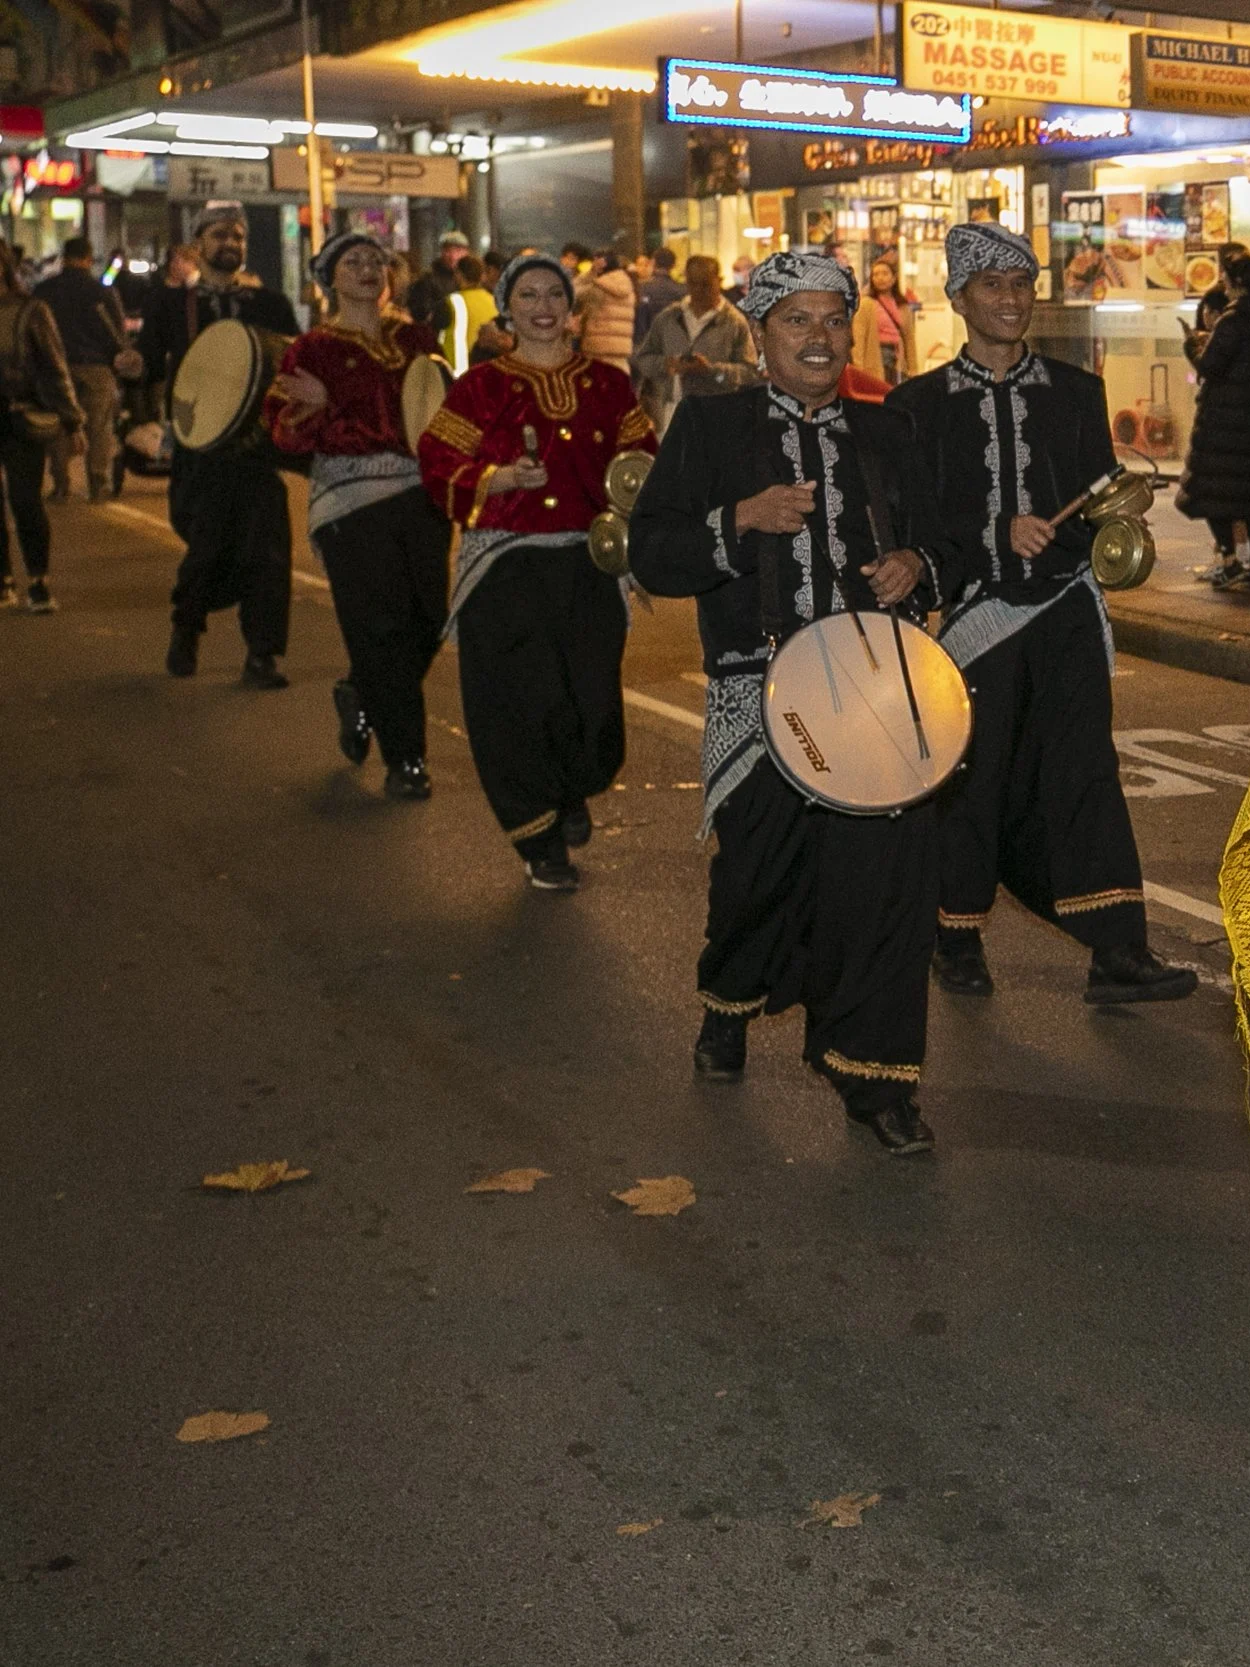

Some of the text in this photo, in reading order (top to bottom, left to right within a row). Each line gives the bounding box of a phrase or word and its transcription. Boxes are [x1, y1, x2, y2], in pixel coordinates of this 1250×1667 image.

[912, 14, 949, 34] 202
[923, 42, 1067, 76] MASSAGE
[1152, 39, 1234, 63] MICHAEL
[932, 70, 1058, 95] 0451 537 999
[1153, 63, 1198, 81] PUBLIC
[783, 712, 831, 773] ROLLING
